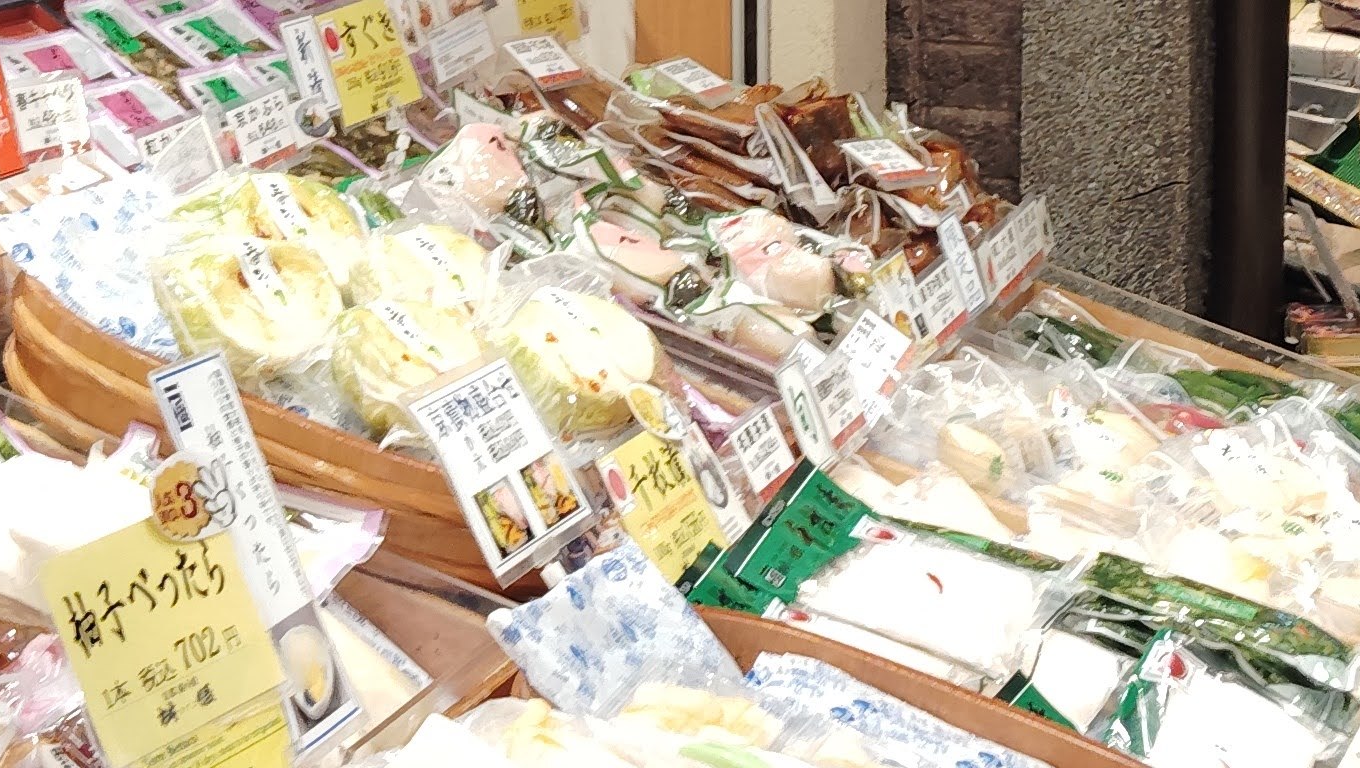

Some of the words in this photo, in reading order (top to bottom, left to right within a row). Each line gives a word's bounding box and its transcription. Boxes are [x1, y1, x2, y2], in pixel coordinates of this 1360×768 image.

[340, 10, 396, 58] すぐき
[62, 539, 226, 659] 柚子べったら
